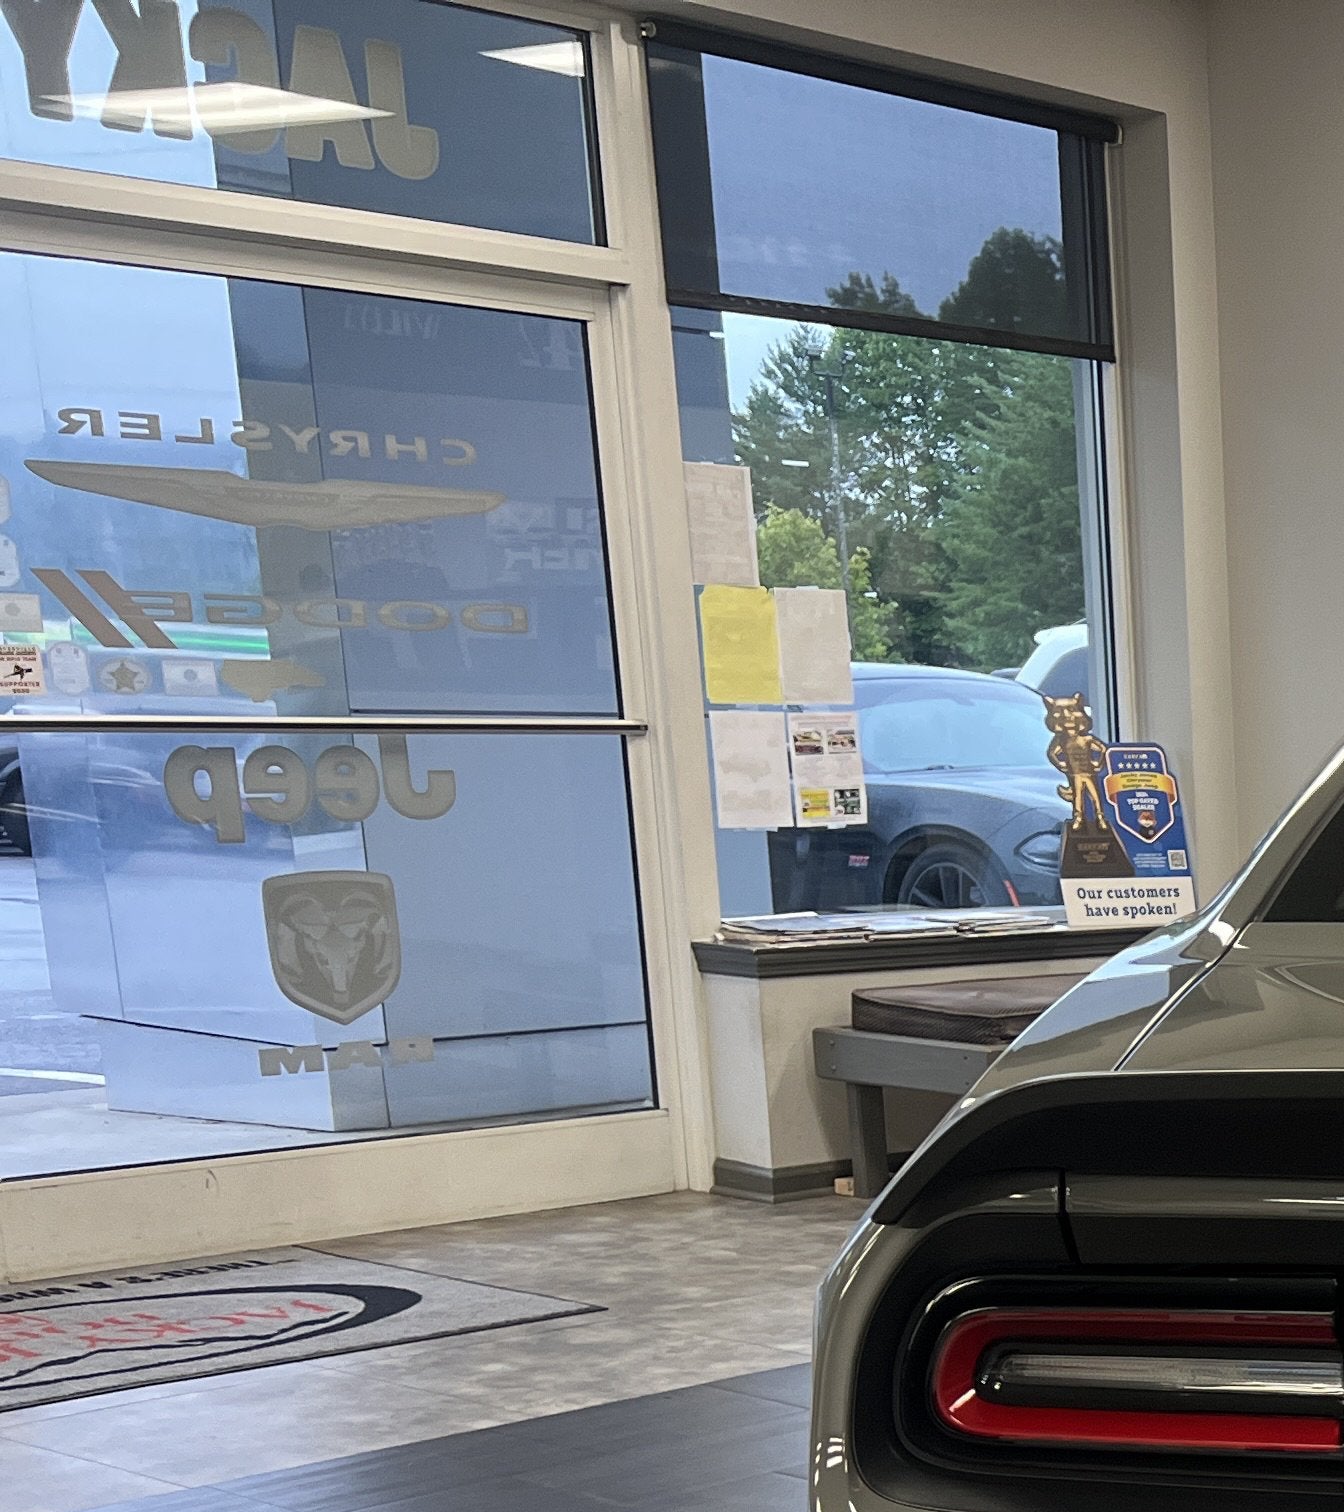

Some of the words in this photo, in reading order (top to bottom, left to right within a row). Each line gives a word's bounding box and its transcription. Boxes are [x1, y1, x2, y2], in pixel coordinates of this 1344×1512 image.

[1077, 887, 1102, 899] Our
[1106, 887, 1180, 899] customers
[1084, 904, 1119, 917] have
[1122, 903, 1177, 919] spoken!
